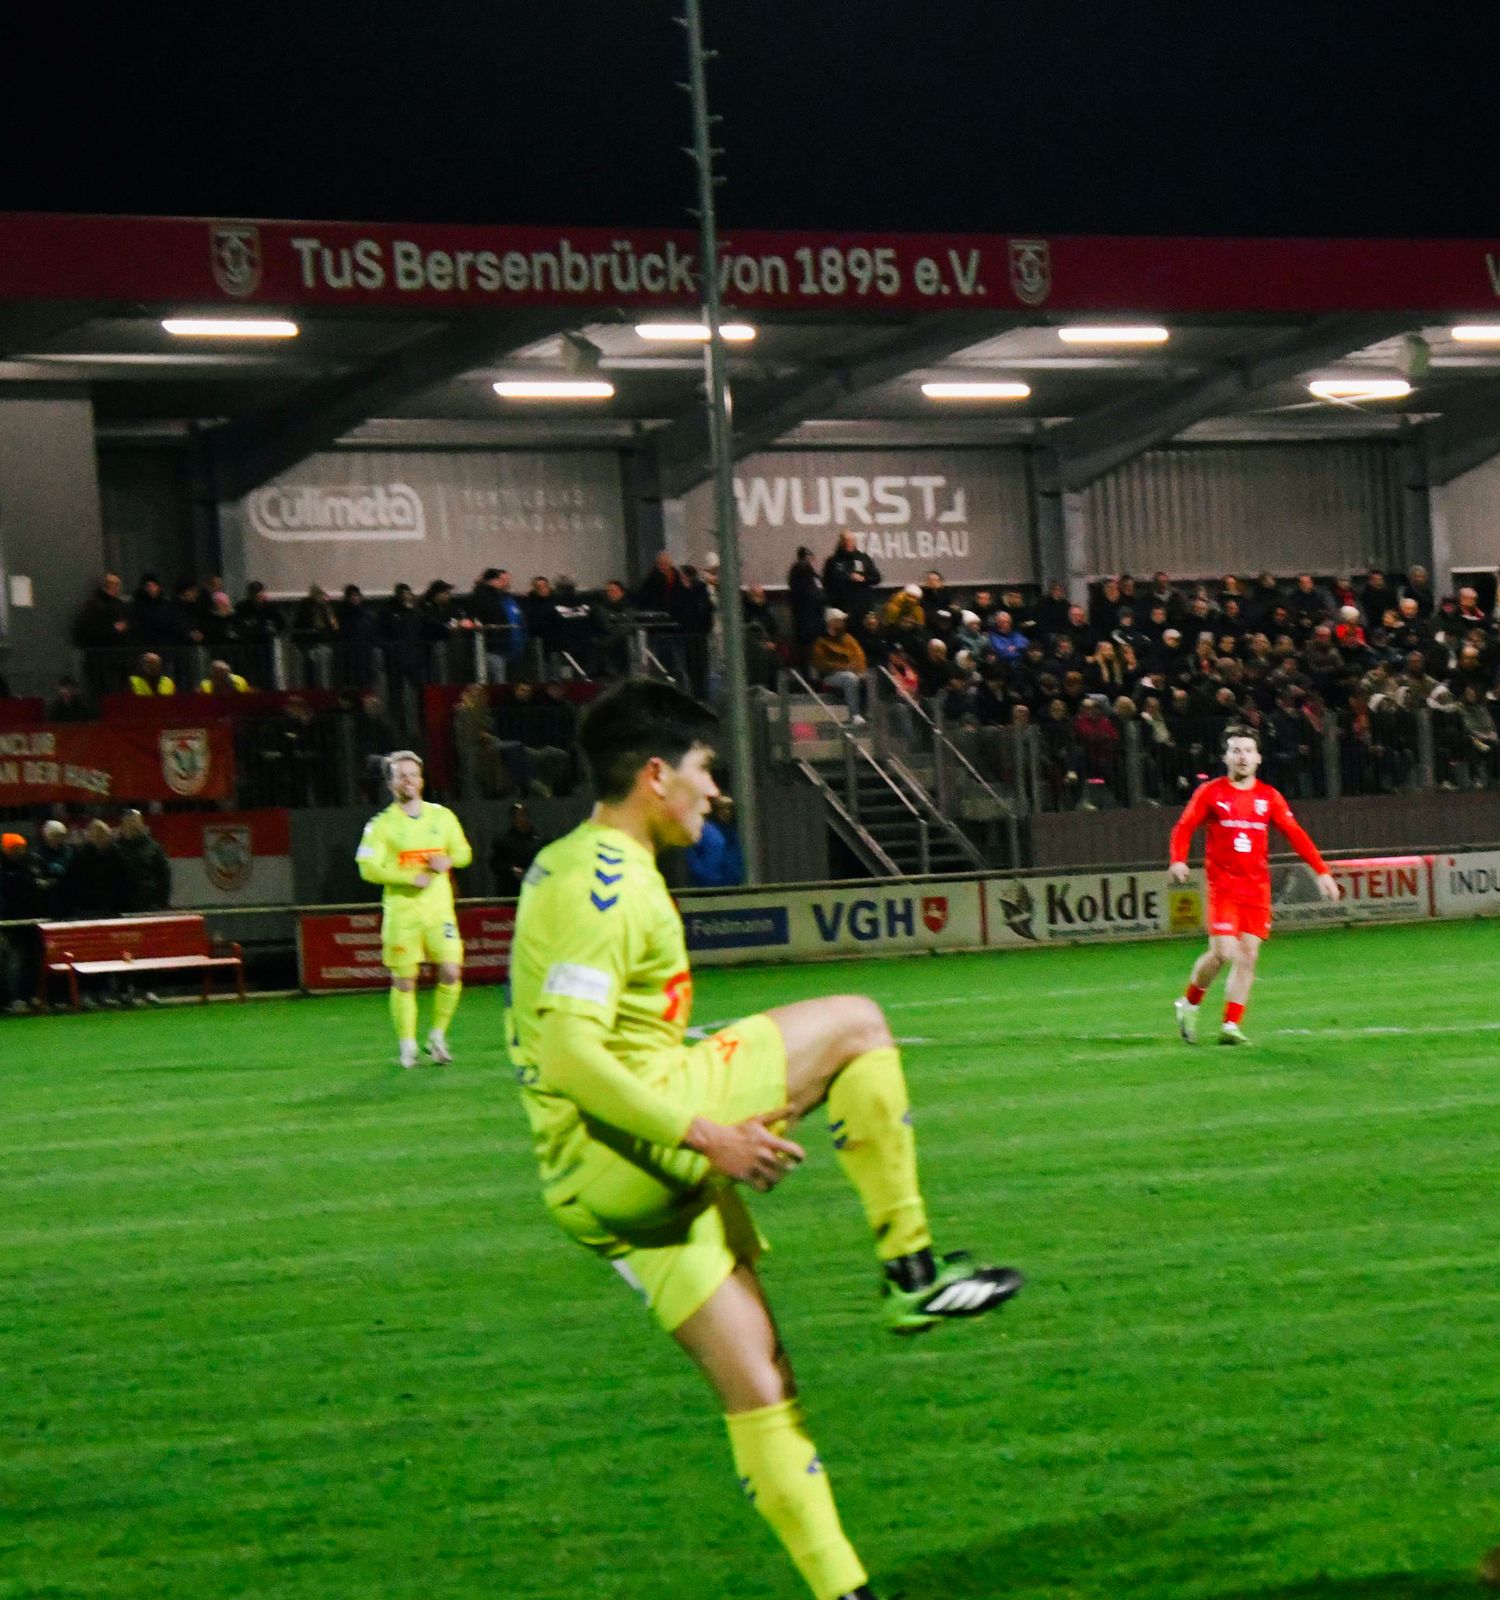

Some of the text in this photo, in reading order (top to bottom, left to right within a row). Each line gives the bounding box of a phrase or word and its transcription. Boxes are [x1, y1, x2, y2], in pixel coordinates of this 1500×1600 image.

[291, 238, 386, 290] TuS
[398, 239, 698, 294] Bersenbrück
[795, 247, 901, 296] 1895
[914, 248, 987, 296] e.V.
[732, 475, 946, 527] WURST
[852, 530, 969, 560] TAHLBAU
[812, 898, 915, 943] VGH
